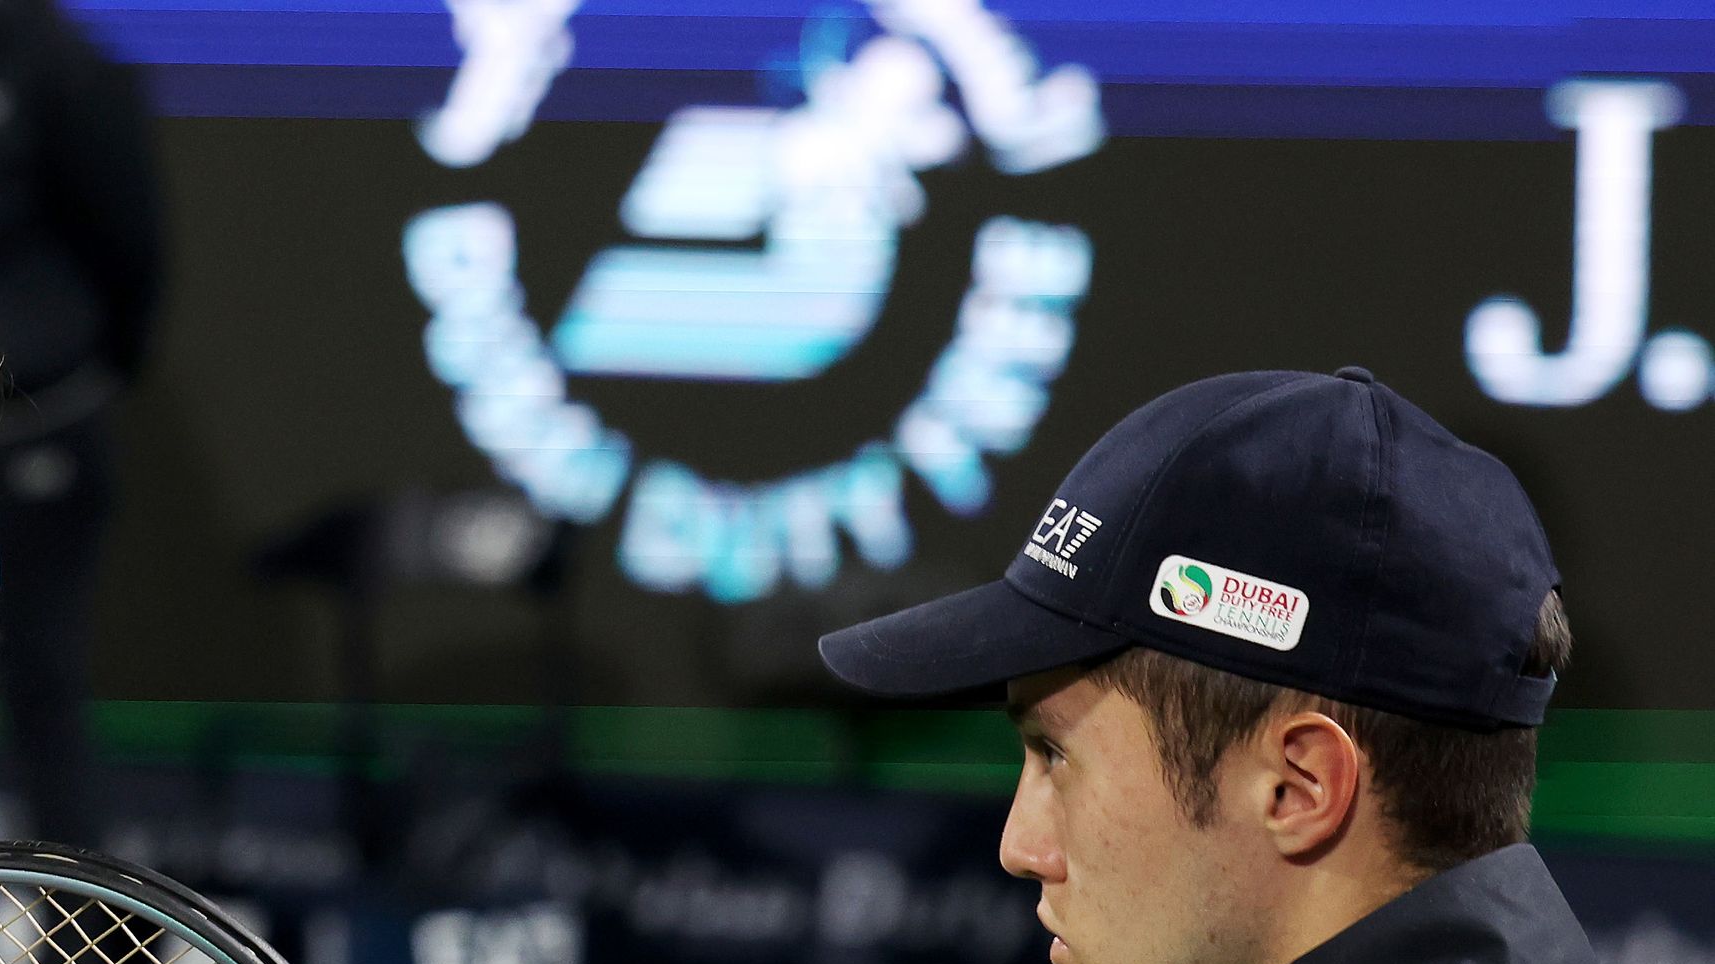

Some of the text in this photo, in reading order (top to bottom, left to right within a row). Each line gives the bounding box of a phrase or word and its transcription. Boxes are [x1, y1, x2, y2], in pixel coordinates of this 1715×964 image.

[1463, 78, 1714, 412] J.
[1032, 498, 1103, 559] EA7
[1220, 592, 1294, 623] DUTY FREE
[1222, 576, 1300, 612] DUBAI
[1217, 603, 1290, 635] TENNIS
